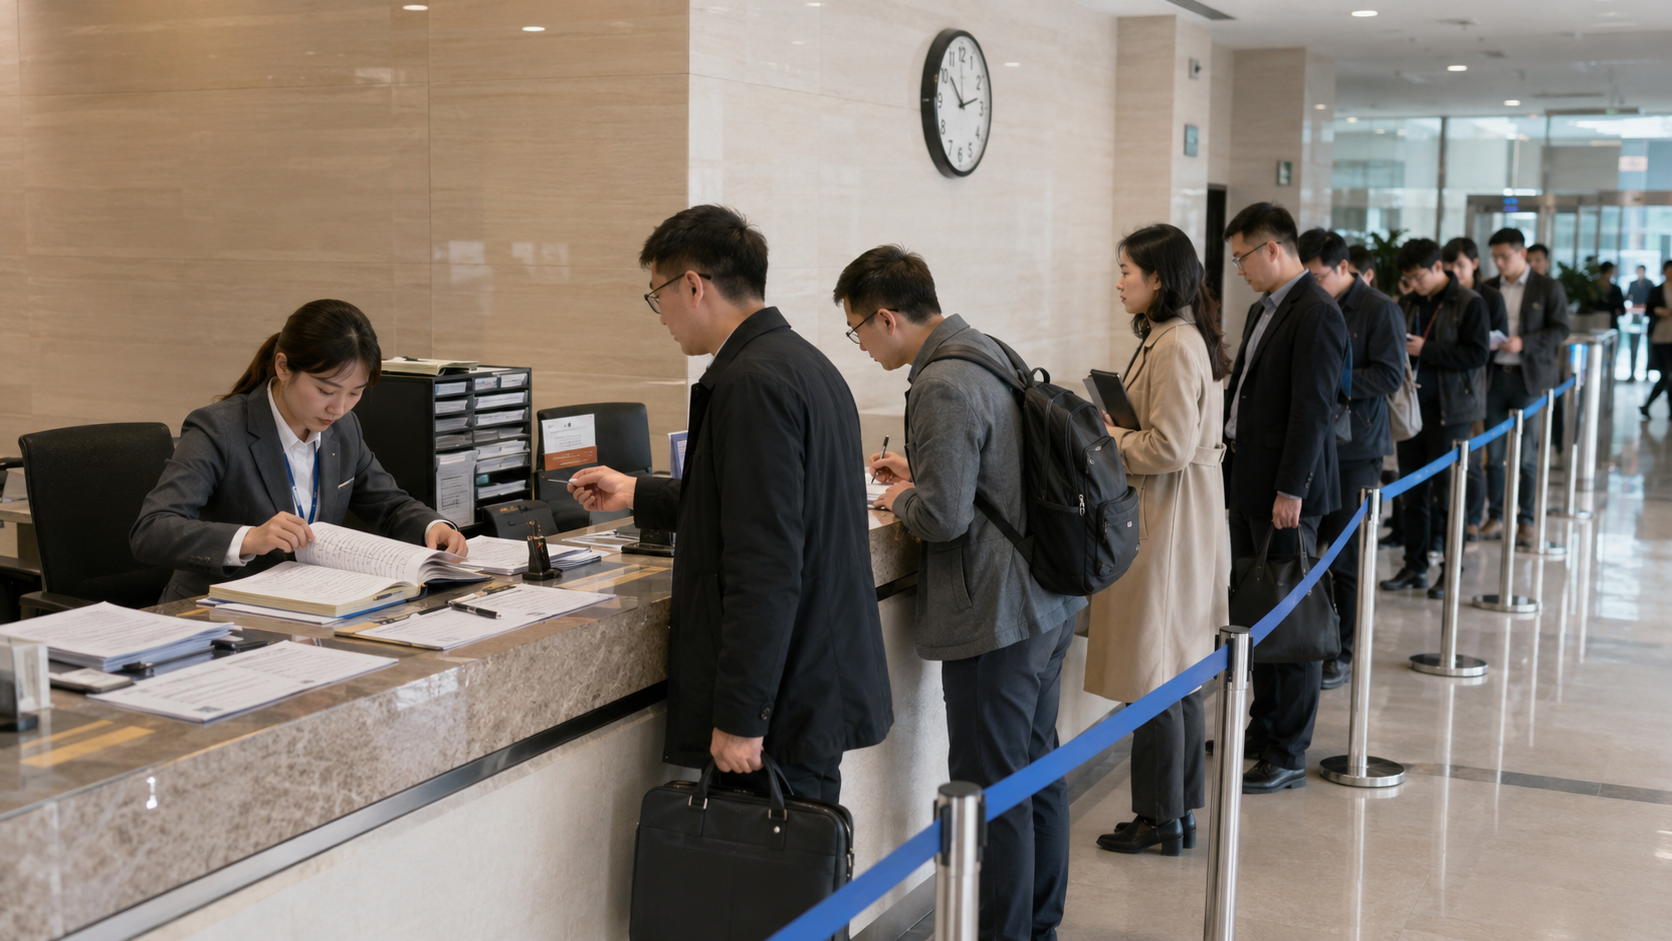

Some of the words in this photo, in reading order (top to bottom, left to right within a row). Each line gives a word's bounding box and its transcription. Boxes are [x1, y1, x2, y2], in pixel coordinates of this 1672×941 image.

[949, 51, 955, 67] 11
[958, 46, 966, 63] 12
[970, 55, 973, 70] 1
[940, 68, 948, 84] 10
[976, 75, 981, 90] 2
[938, 92, 943, 109] 9
[979, 100, 984, 117] 3
[941, 119, 946, 135] 8
[975, 125, 980, 140] 4
[948, 139, 953, 156] 7
[957, 147, 963, 163] 6
[968, 142, 973, 158] 5
